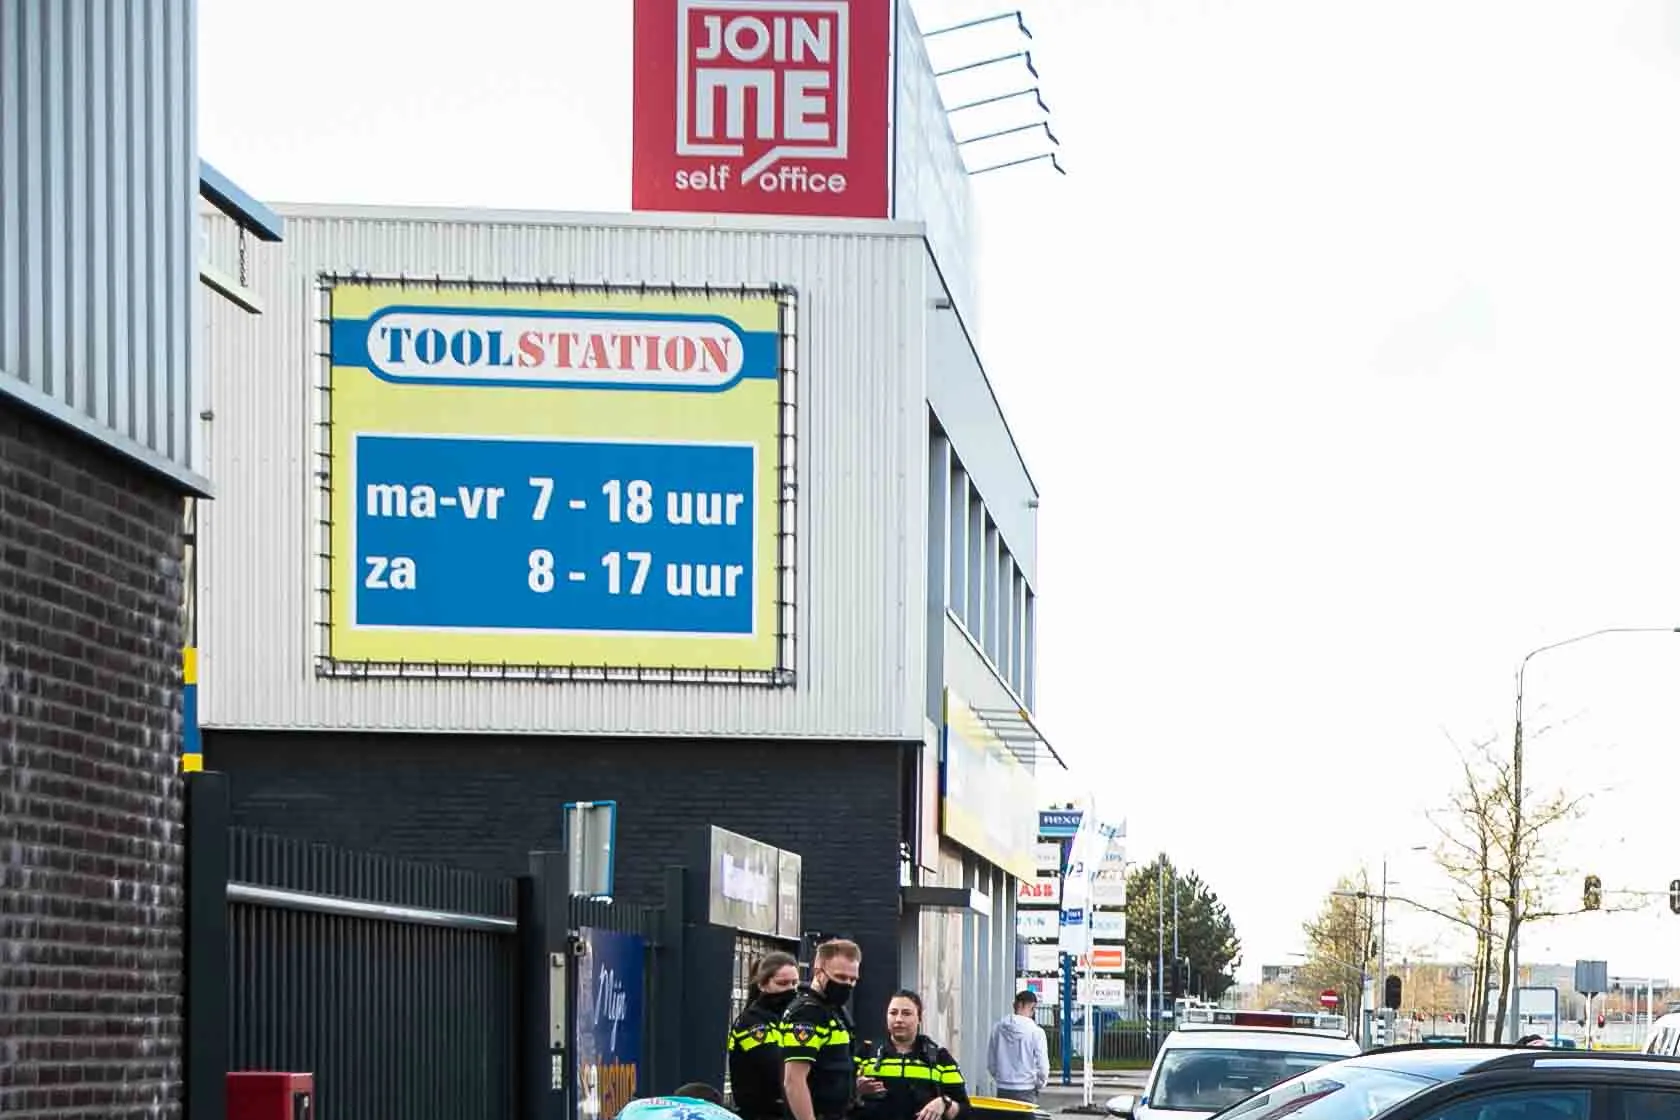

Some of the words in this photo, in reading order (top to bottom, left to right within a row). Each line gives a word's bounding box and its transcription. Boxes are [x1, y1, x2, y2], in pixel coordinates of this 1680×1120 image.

[696, 16, 831, 63] JOIN
[695, 68, 830, 141] ME
[675, 164, 730, 191] self
[759, 165, 848, 194] office
[380, 326, 731, 374] TOOLSTATION
[366, 482, 504, 520] ma-vr
[529, 477, 554, 521] 7
[602, 479, 652, 523] 18
[667, 492, 743, 525] uur
[366, 555, 416, 589] za
[528, 549, 554, 593] 8
[602, 551, 652, 594] 17
[666, 564, 743, 597] uur
